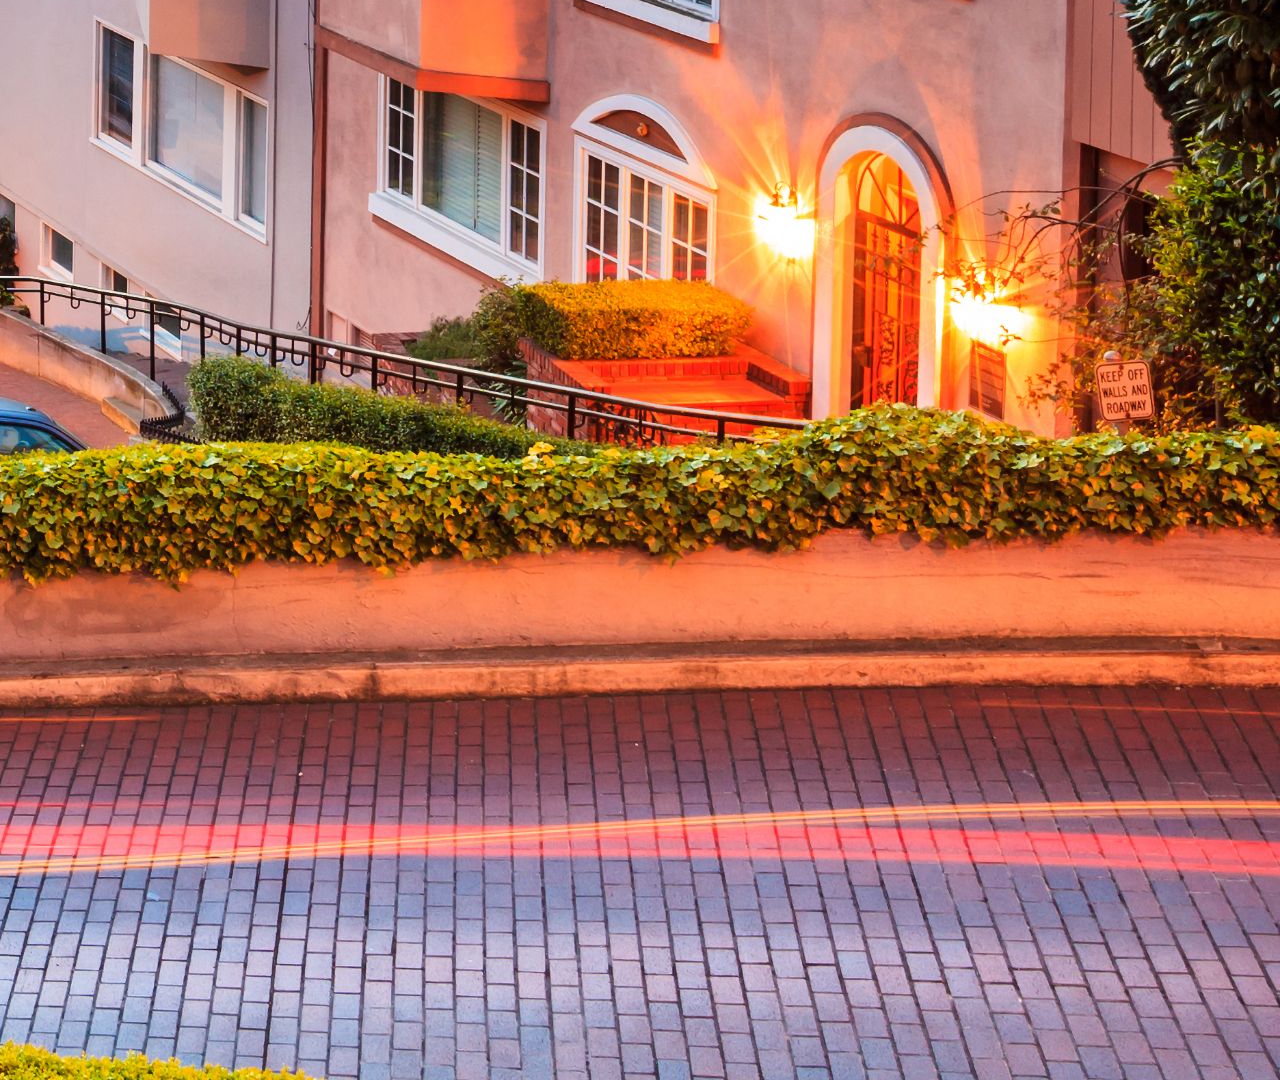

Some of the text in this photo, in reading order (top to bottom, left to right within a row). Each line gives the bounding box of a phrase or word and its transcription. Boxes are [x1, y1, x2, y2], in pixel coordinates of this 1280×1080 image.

[1100, 368, 1144, 383] KEEP OFF
[1101, 384, 1148, 398] WALLS AND
[1106, 400, 1146, 414] ROADWAY
